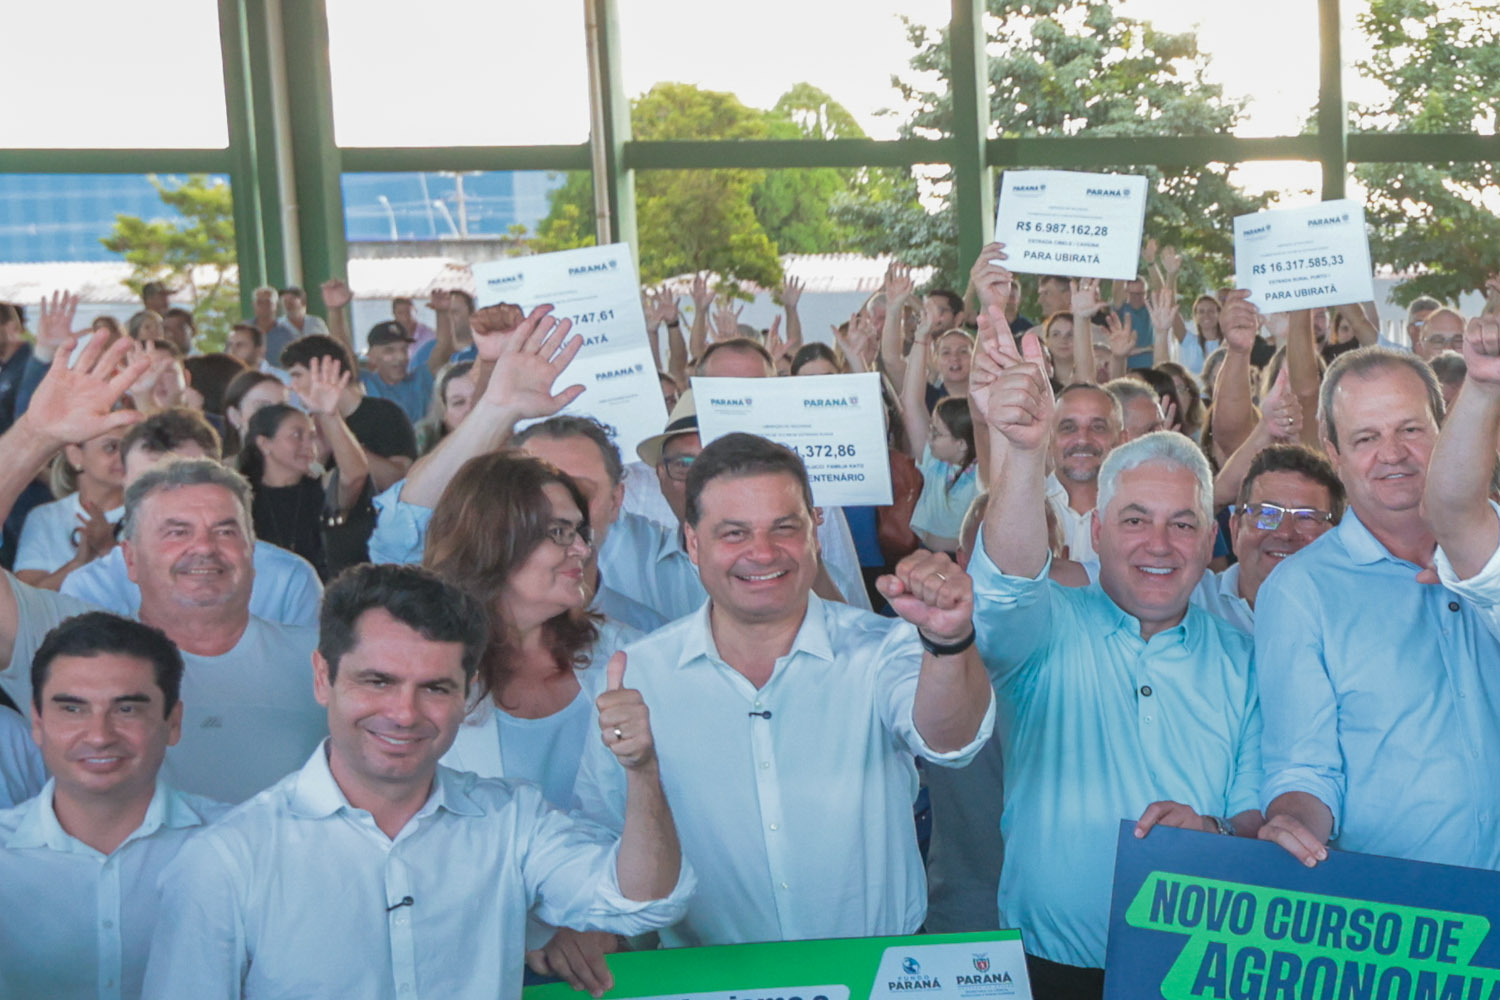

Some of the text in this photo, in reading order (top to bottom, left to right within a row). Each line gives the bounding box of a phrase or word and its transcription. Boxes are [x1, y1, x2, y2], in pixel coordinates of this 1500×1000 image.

[1016, 221, 1108, 236] R$ 6.987.162,28
[1024, 250, 1052, 260] PARA
[1253, 255, 1344, 275] R$ 16.317.585,33
[1265, 291, 1292, 301] PARA
[573, 309, 615, 325] 747,61
[794, 444, 856, 459] 1.372,86
[808, 473, 865, 483] ENTENÁRIO
[1149, 879, 1464, 964] NOVO CURSO DE
[888, 978, 941, 991] PARANÁ
[956, 971, 1012, 985] PARANÁ
